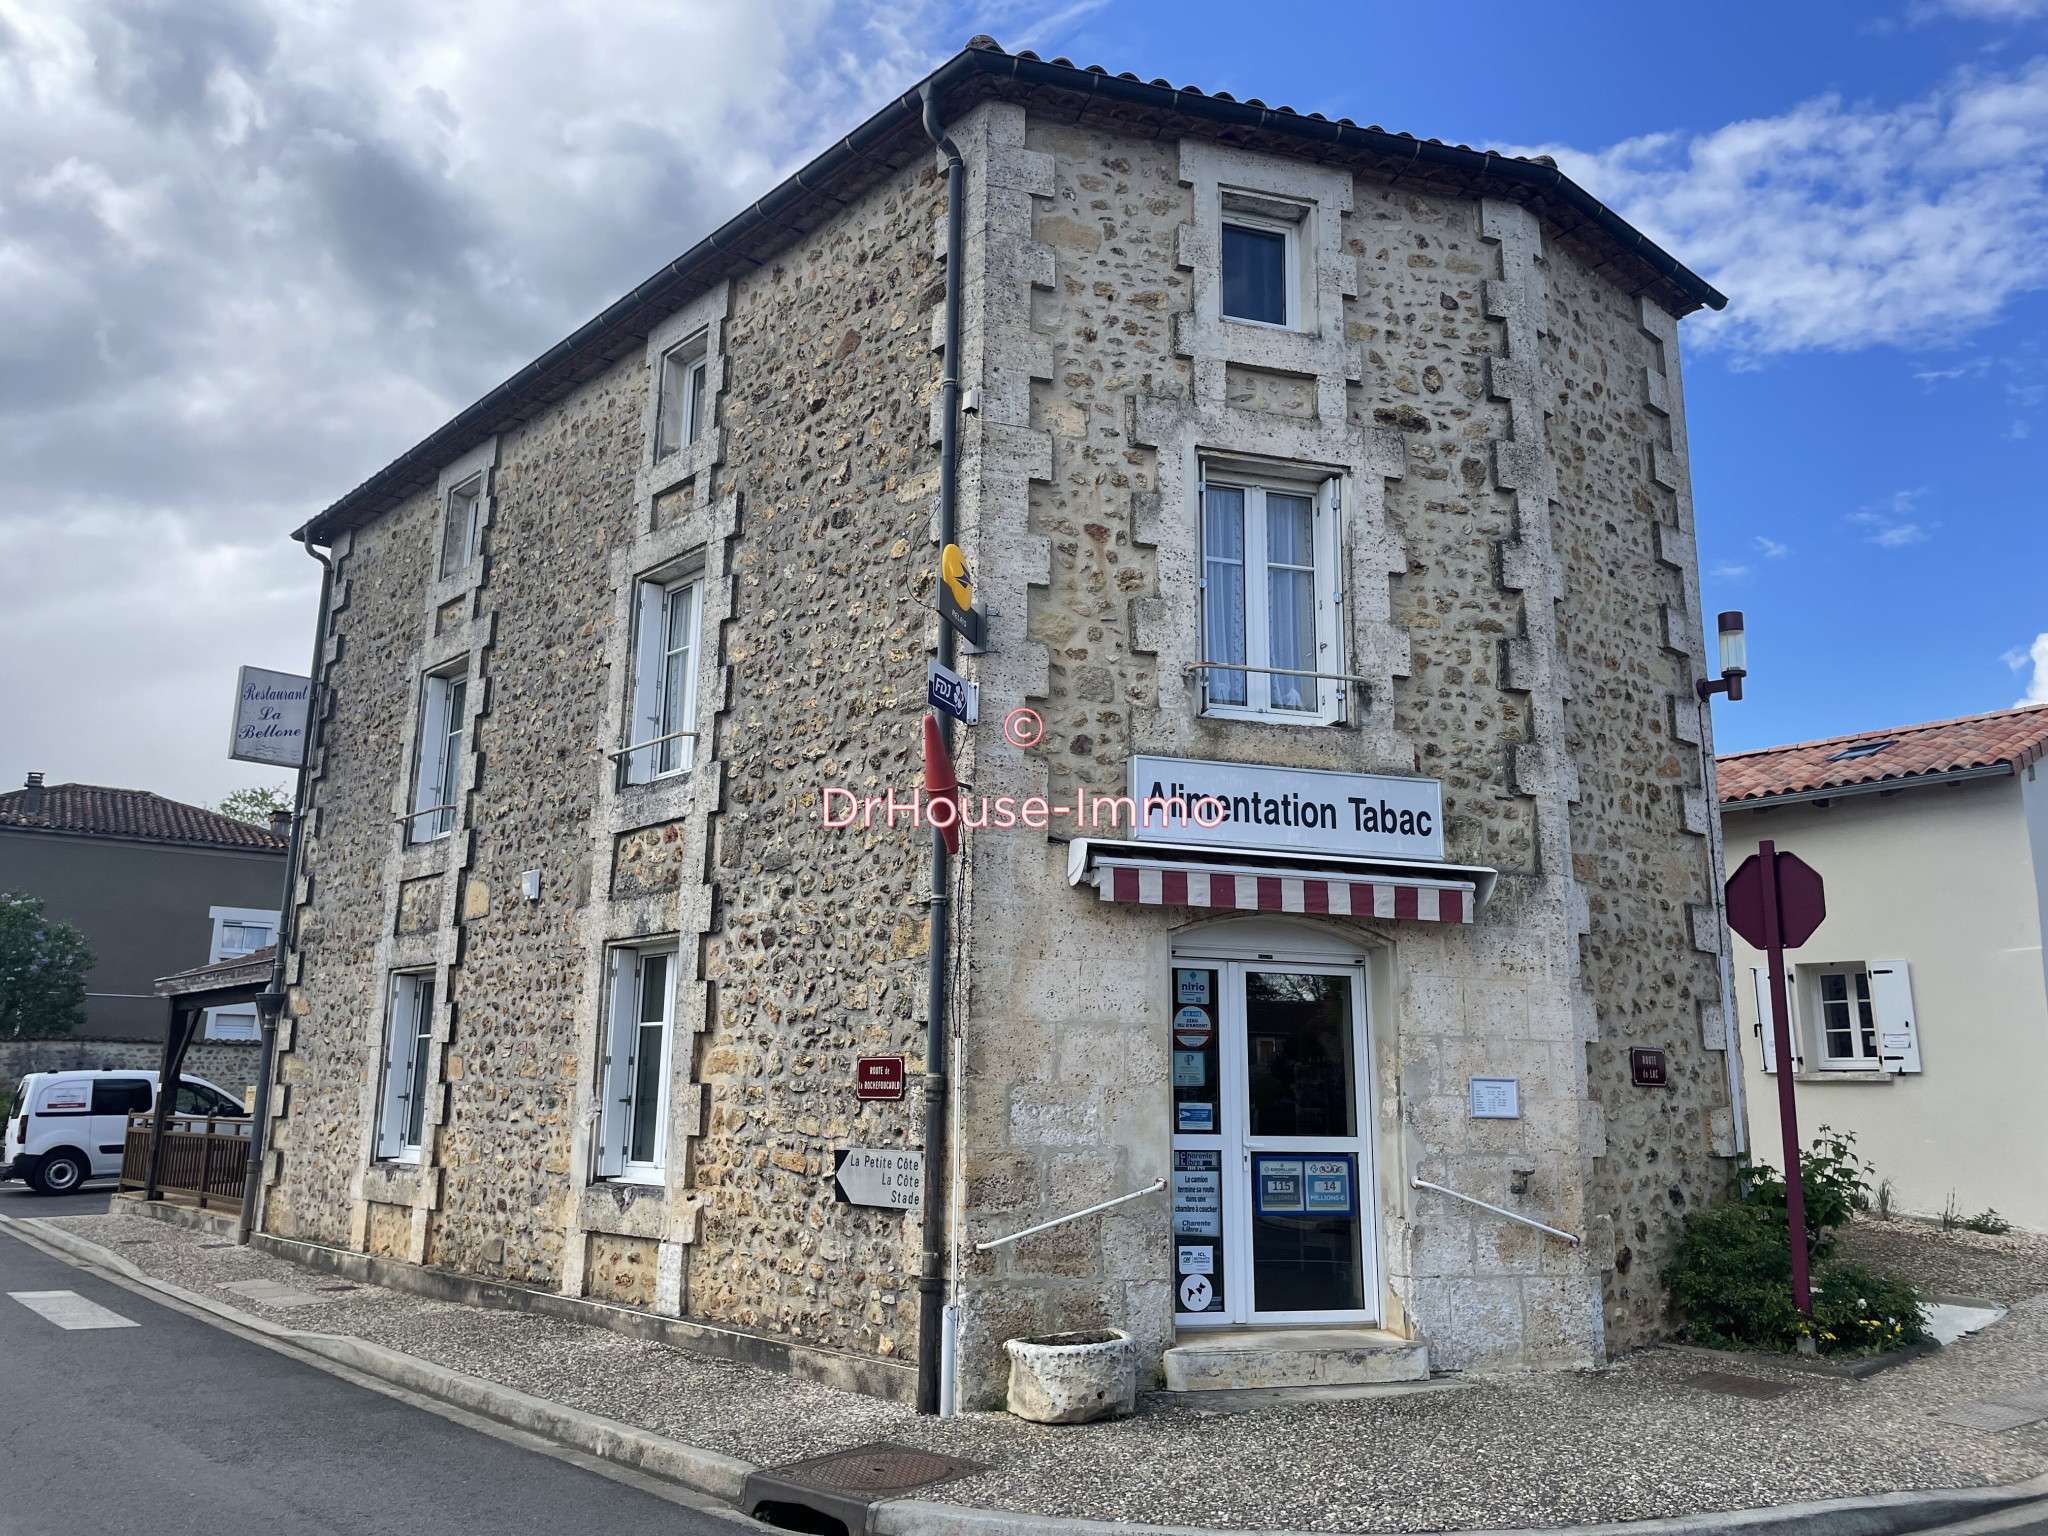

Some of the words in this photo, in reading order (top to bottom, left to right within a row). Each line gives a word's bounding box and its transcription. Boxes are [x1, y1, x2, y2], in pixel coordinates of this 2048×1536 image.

[243, 682, 308, 700] Restaurant
[935, 677, 951, 698] FDJ
[258, 706, 282, 720] La
[239, 724, 302, 739] Bellone
[1148, 781, 1337, 829] Alimentation
[1348, 796, 1432, 836] Tabac
[869, 1066, 883, 1075] ROUTE
[885, 1066, 890, 1075] de
[864, 1081, 900, 1090] ROCHEFOUCAULD
[850, 1155, 860, 1167] La
[864, 1155, 892, 1170] Petite
[897, 1155, 919, 1171] Côte
[881, 1173, 892, 1186] La
[896, 1173, 920, 1188] Côte
[1323, 1181, 1337, 1191] 14
[891, 1190, 920, 1205] Stade
[1182, 1219, 1211, 1227] Charente
